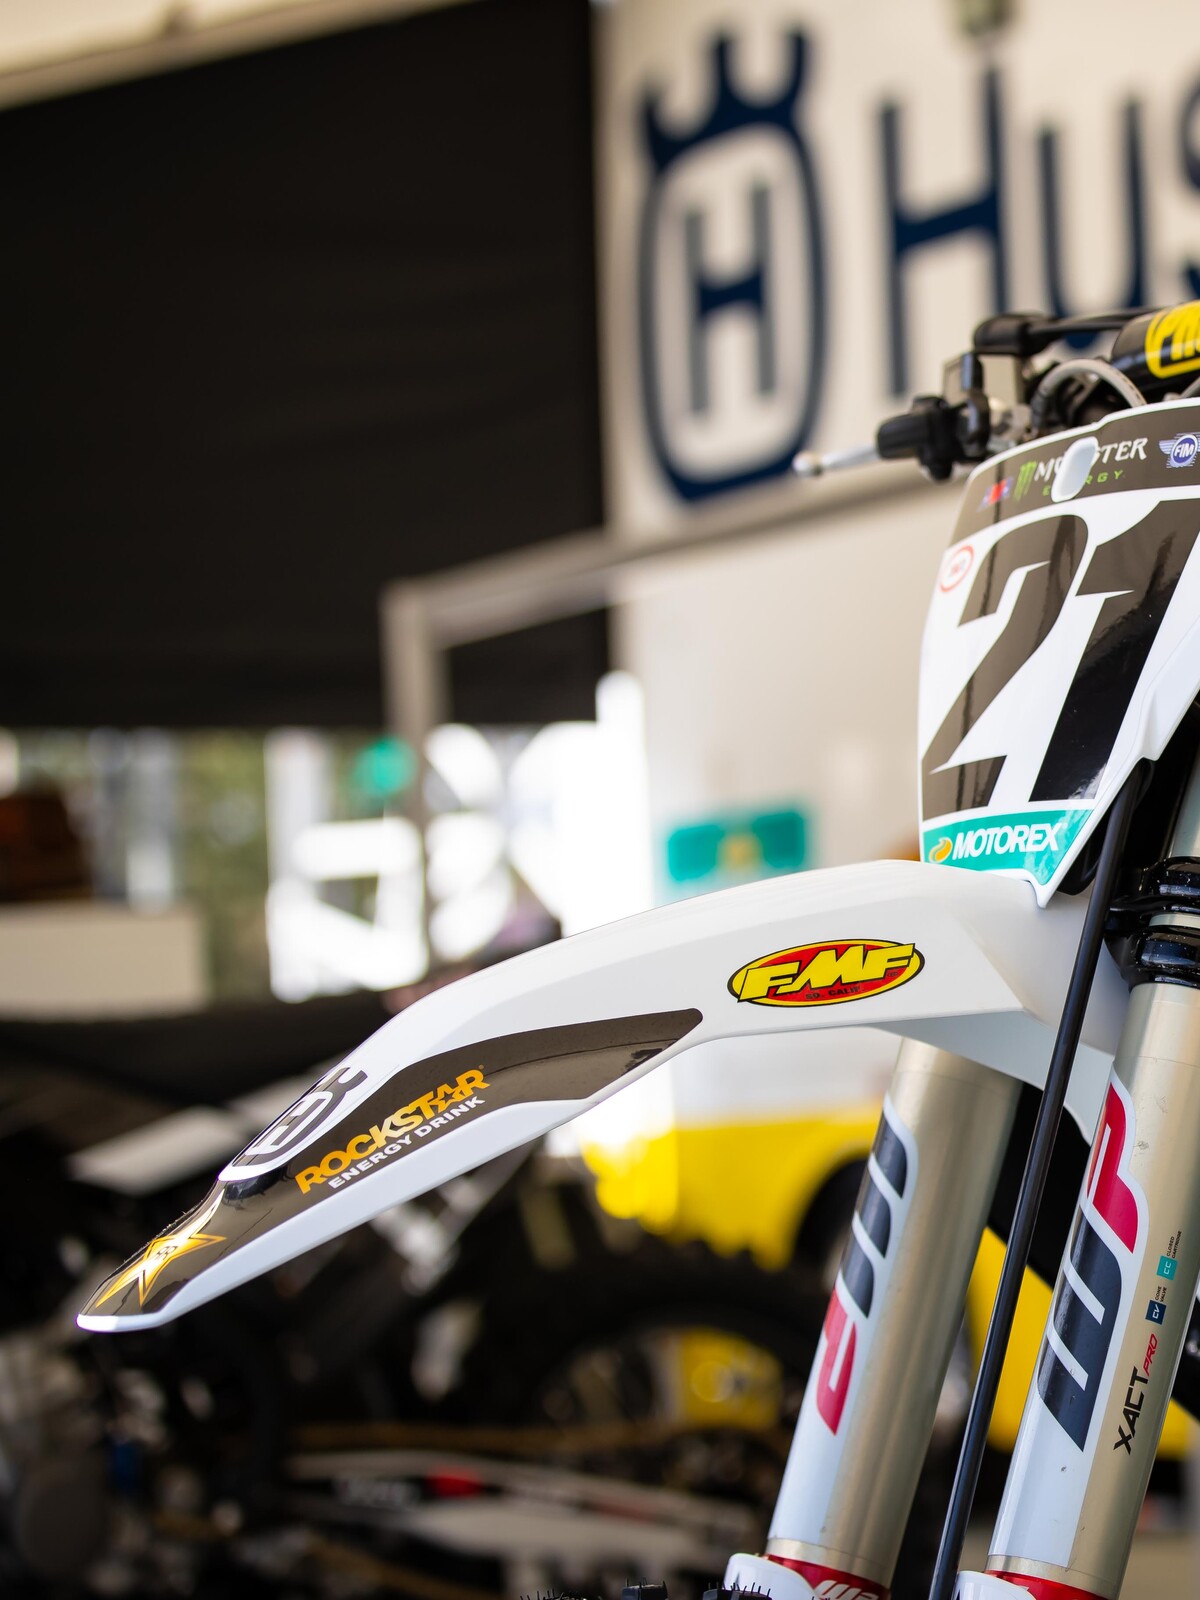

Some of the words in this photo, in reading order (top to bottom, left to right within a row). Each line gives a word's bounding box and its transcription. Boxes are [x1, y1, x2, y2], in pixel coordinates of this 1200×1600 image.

[1034, 437, 1148, 482] MTER
[1174, 442, 1195, 458] FIM
[1042, 469, 1124, 497] ERGY
[951, 822, 1068, 861] MOTOREX
[737, 943, 915, 1003] FMF
[294, 1068, 491, 1195] ROCKSTAR
[328, 1134, 413, 1189] ENERGY
[413, 1095, 486, 1138] DRINK
[1112, 1365, 1149, 1456] XACT
[1142, 1333, 1158, 1377] PRO
